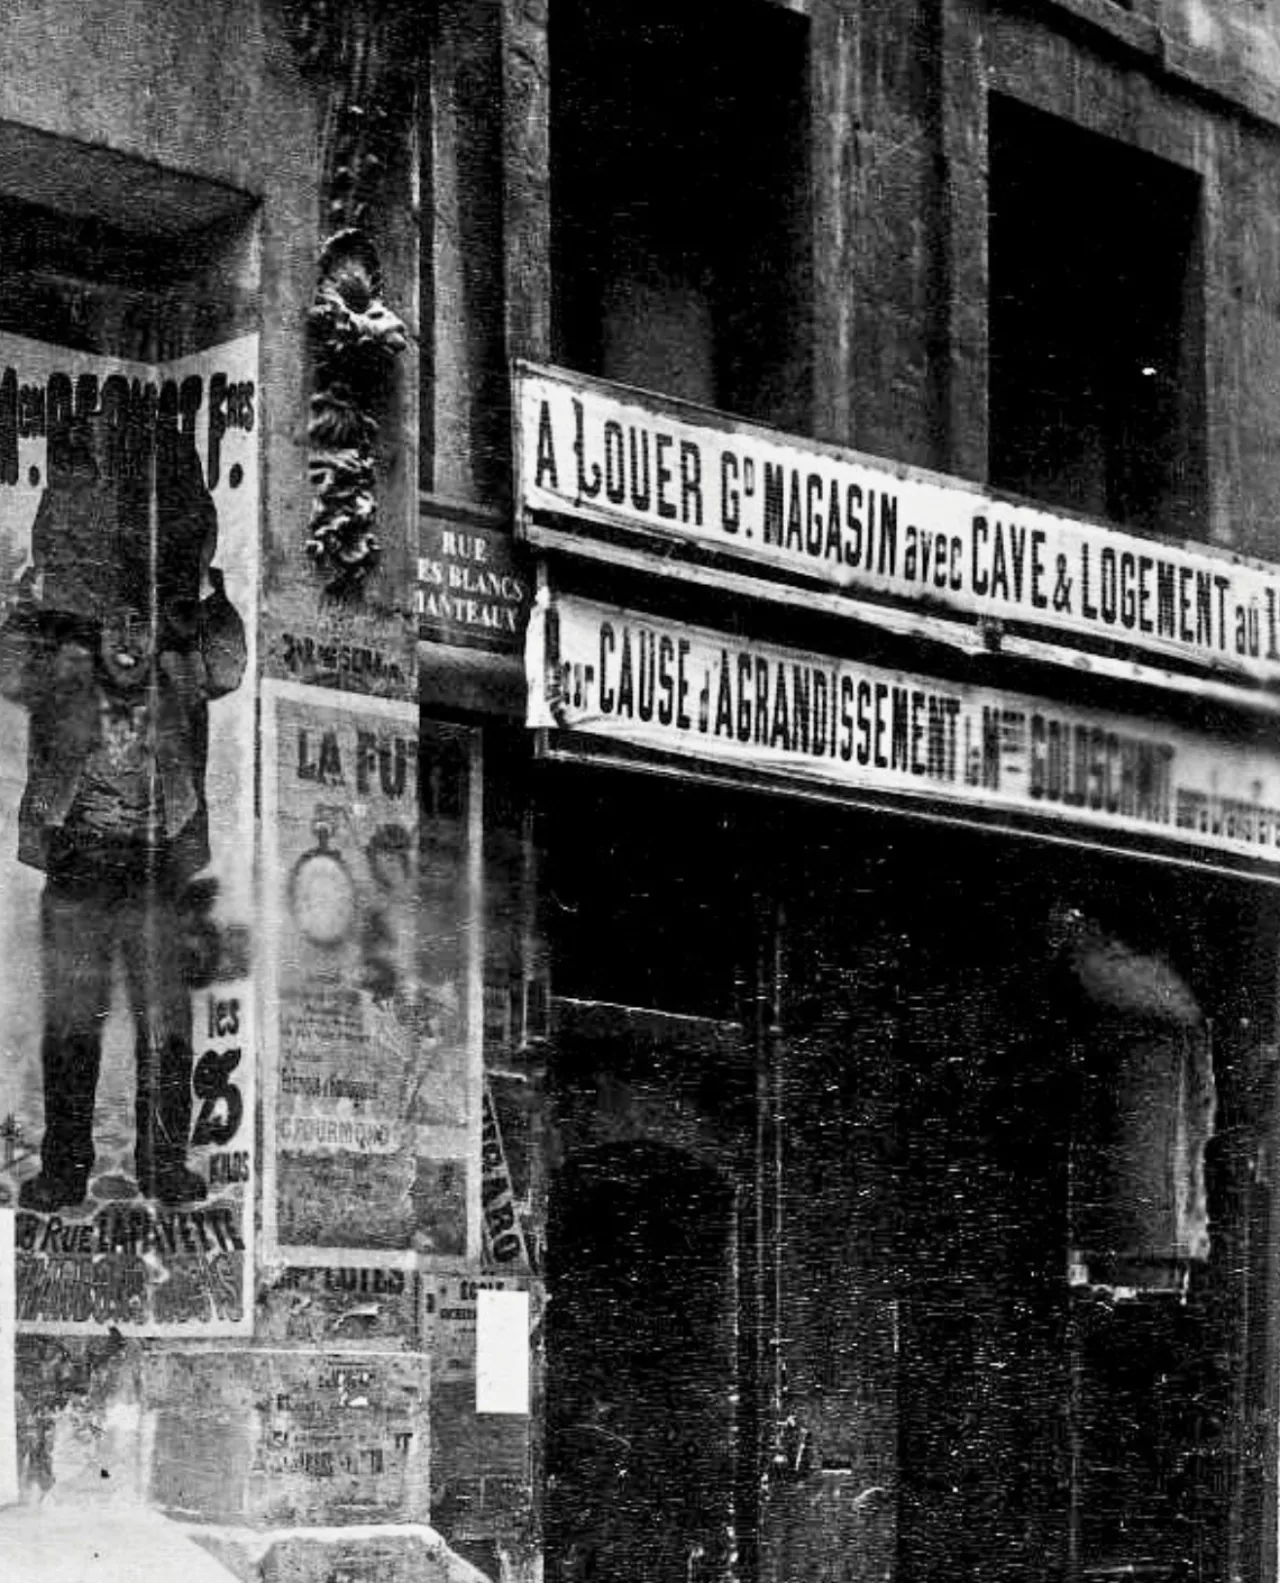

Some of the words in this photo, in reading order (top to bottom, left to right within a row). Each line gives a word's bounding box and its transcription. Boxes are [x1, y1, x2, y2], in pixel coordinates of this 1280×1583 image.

[441, 531, 487, 562] RUE
[535, 400, 558, 489] A
[572, 398, 703, 527] LOUER
[764, 461, 897, 577] MAGASIN
[905, 525, 963, 591] avec
[973, 516, 1047, 609] CAVE
[1053, 553, 1073, 615] &
[1081, 542, 1231, 651] LOGEMENT
[1236, 604, 1260, 657] au
[415, 557, 442, 584] ES
[448, 563, 523, 601] BLANCS
[600, 621, 690, 731] CAUSE
